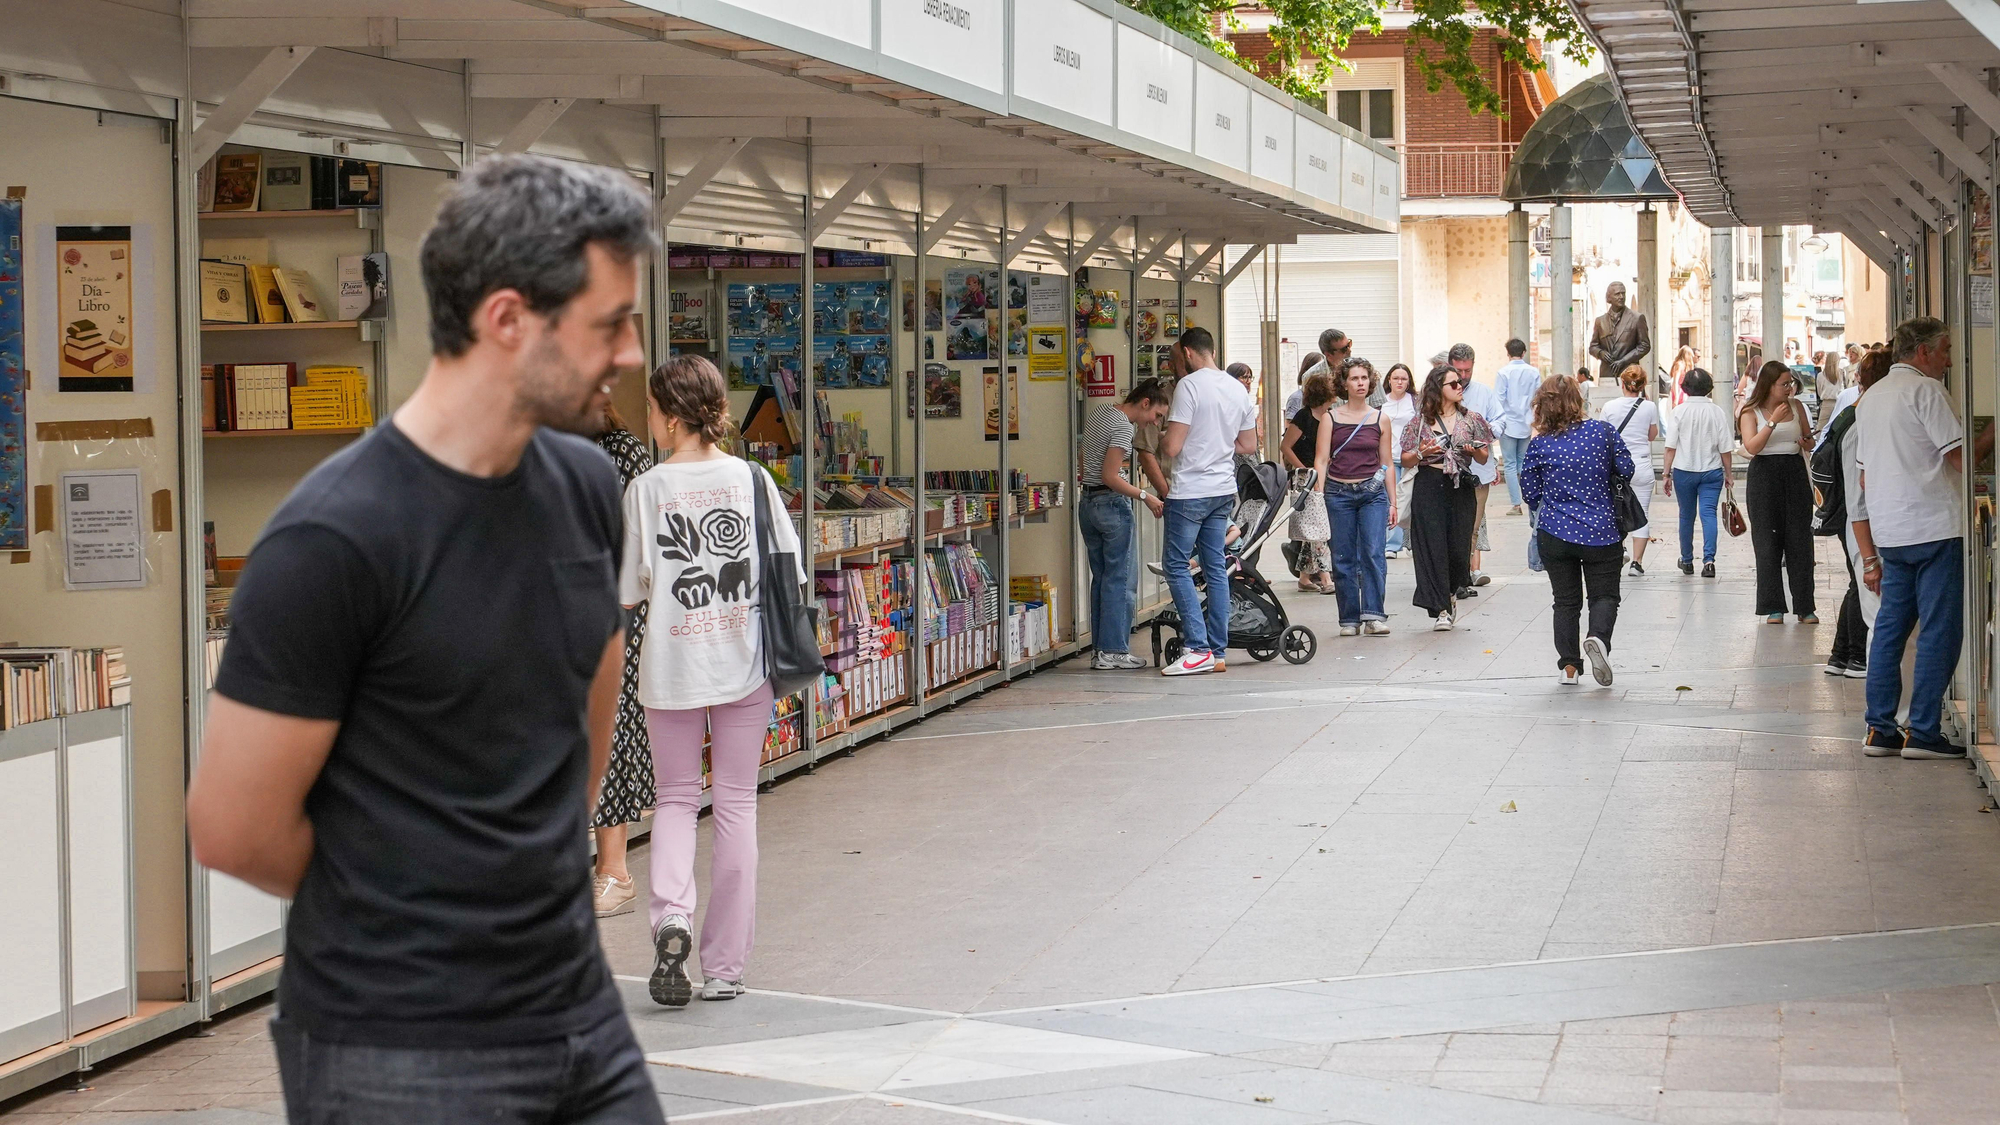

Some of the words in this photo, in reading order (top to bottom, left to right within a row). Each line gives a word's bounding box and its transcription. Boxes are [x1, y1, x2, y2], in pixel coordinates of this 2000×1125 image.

[82, 284, 102, 296] Día
[78, 299, 110, 311] Libro
[671, 293, 687, 312] SEAT
[684, 299, 702, 307] 600
[672, 491, 705, 501] JUST
[709, 486, 740, 496] WAIT
[657, 502, 682, 512] FOR
[686, 498, 722, 508] YOUR
[726, 494, 752, 504] TIME
[685, 609, 728, 624] FULL
[732, 606, 749, 616] OF
[669, 622, 714, 636] GOOD
